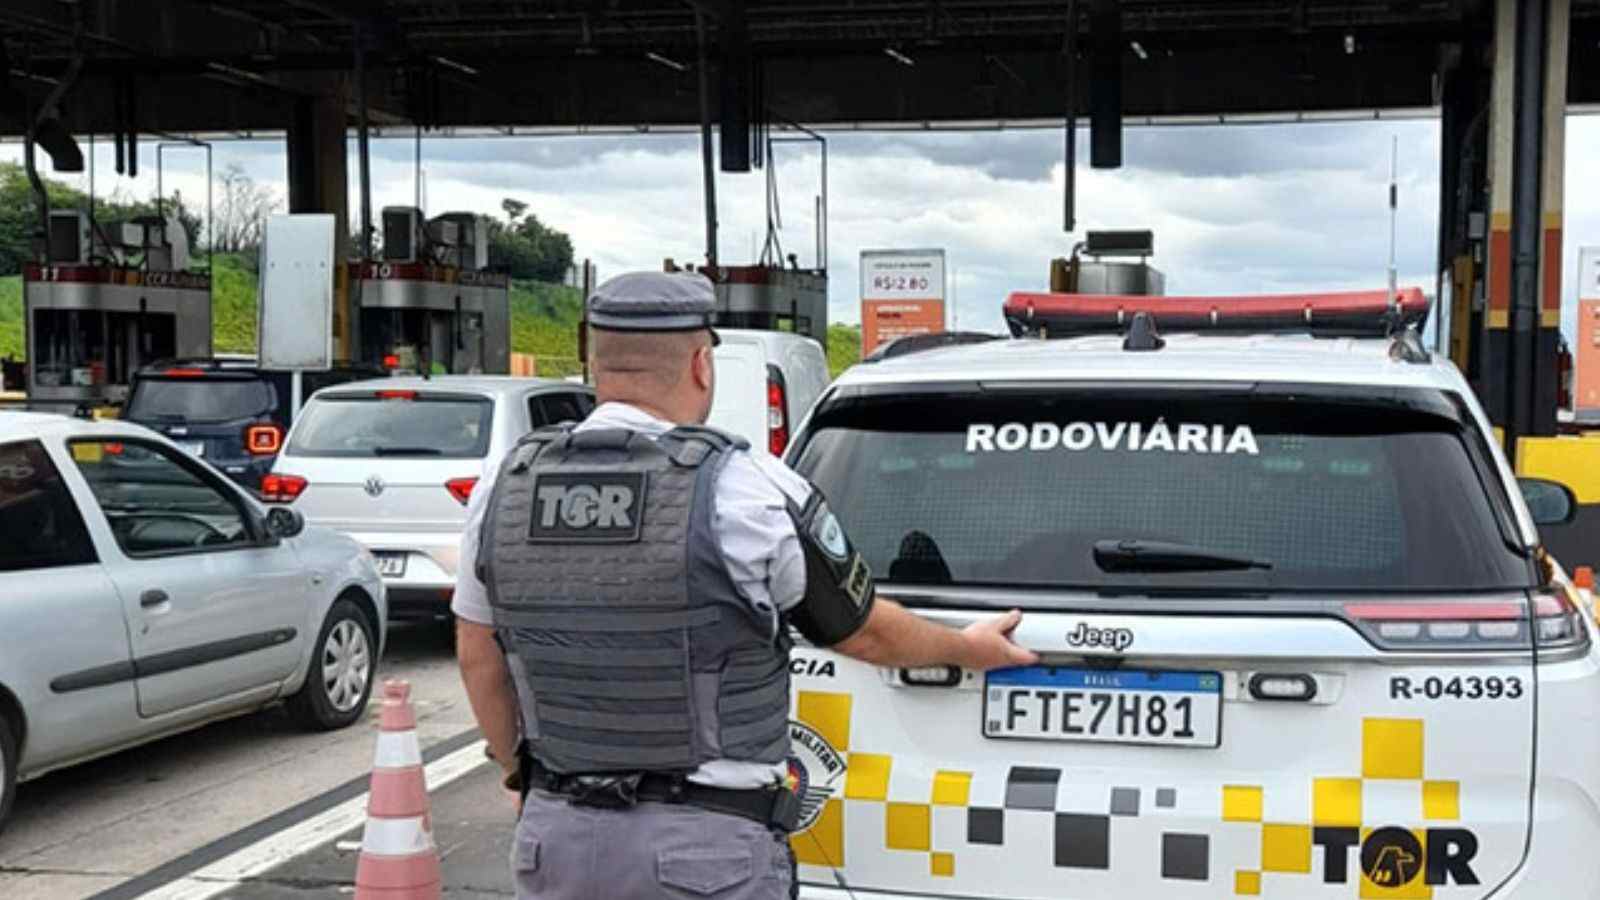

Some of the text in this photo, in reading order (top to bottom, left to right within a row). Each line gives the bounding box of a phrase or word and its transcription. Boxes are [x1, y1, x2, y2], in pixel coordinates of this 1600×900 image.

[966, 416, 1259, 454] RODOVIÁRIA
[538, 484, 633, 527] TOR
[1067, 622, 1134, 652] Jeep
[788, 658, 835, 677] CIA
[1389, 676, 1524, 700] R-04393
[1007, 690, 1195, 738] FTE7H81
[790, 726, 840, 774] MILITAR
[1313, 825, 1480, 888] TOR
